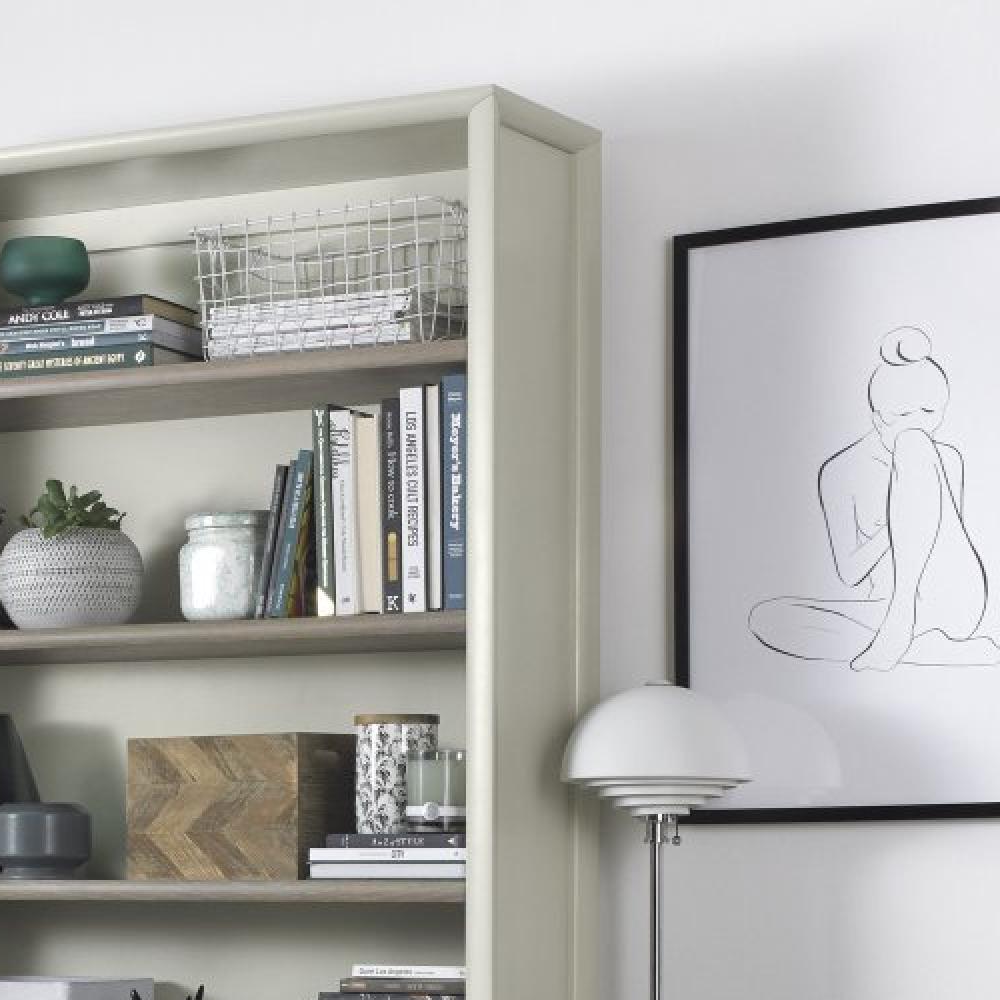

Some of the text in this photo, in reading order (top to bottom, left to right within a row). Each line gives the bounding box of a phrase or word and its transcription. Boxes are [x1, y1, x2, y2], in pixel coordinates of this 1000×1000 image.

[387, 451, 397, 478] How
[405, 411, 419, 547] LOS ANGELES CULT RECIPES
